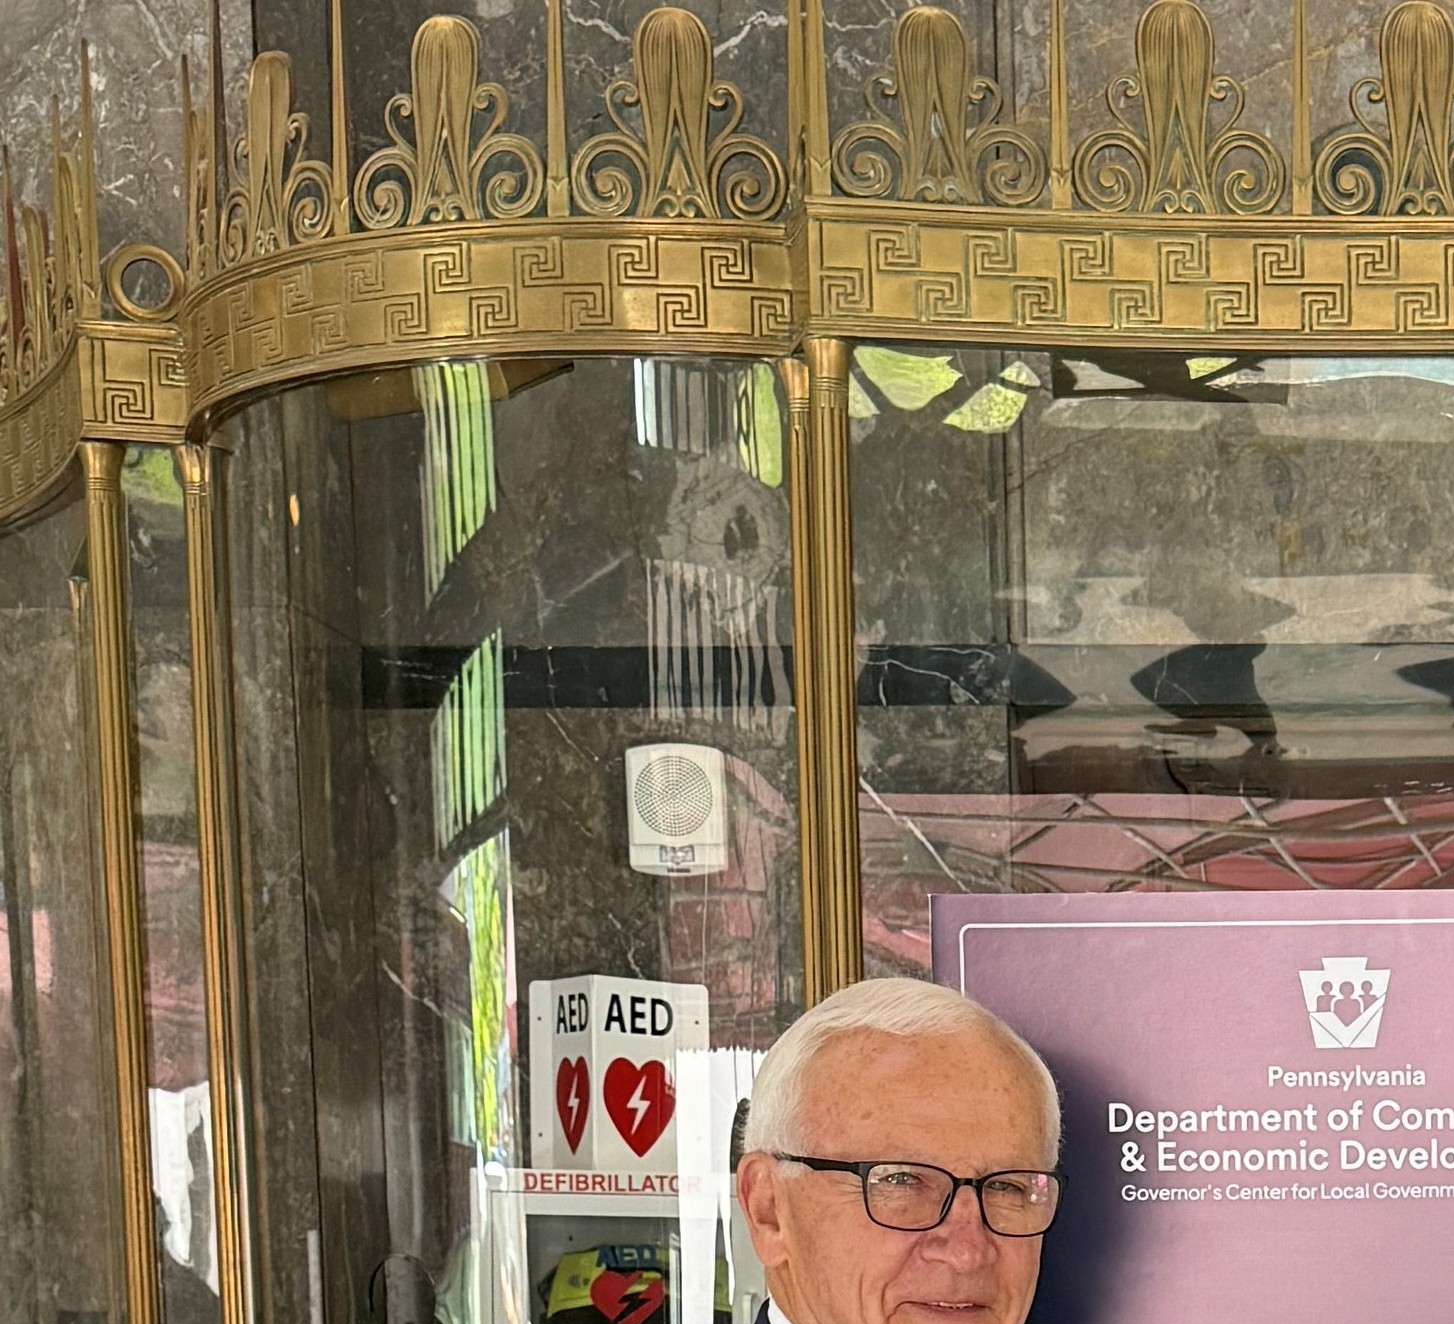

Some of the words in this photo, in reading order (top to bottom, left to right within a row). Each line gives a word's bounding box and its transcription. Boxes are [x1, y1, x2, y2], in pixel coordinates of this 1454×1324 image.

[556, 993, 589, 1034] AED
[604, 994, 673, 1036] AED
[1268, 1064, 1426, 1092] Pennsylvania
[1108, 1102, 1317, 1139] Department
[1327, 1099, 1363, 1131] of
[1120, 1141, 1146, 1172] &
[1157, 1140, 1329, 1172] Economic
[1121, 1184, 1220, 1201] Governor's
[1225, 1183, 1288, 1200] Center
[1291, 1183, 1317, 1200] for
[1320, 1183, 1369, 1200] Local
